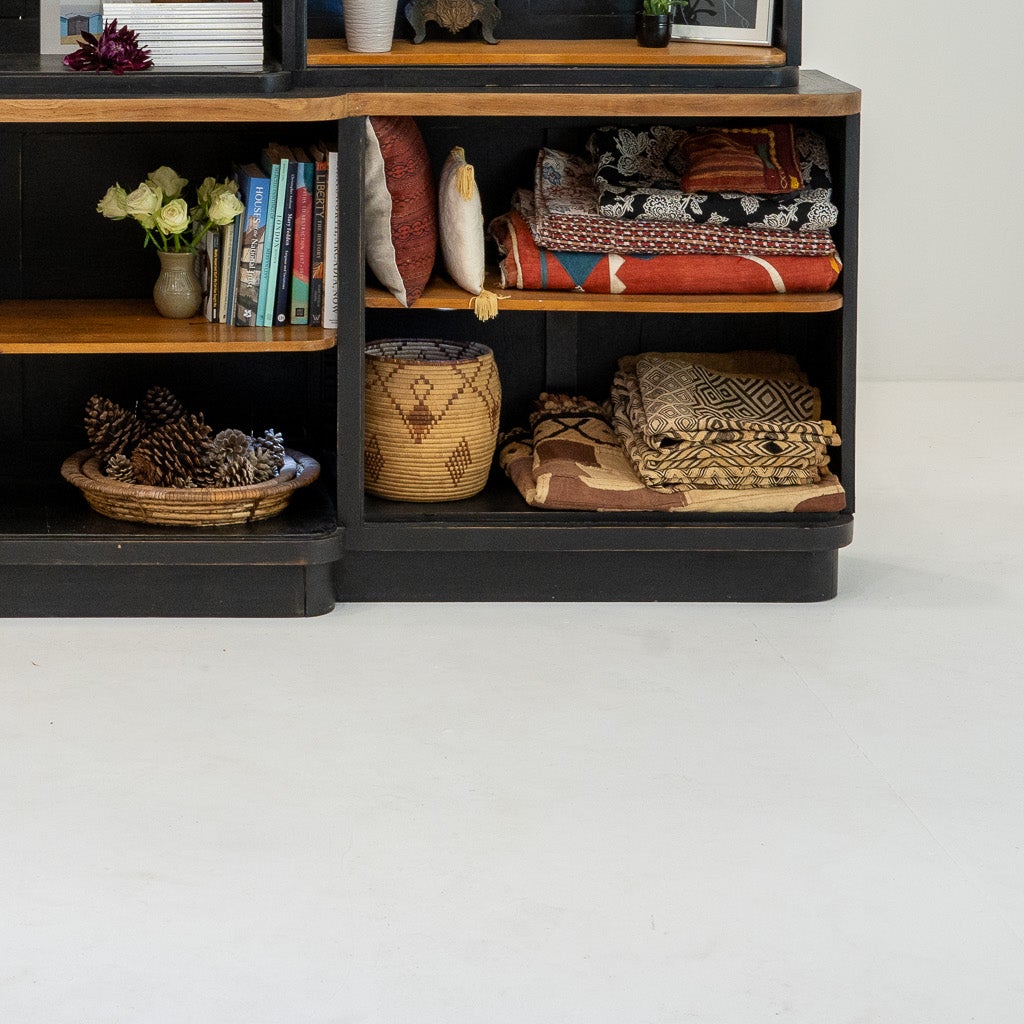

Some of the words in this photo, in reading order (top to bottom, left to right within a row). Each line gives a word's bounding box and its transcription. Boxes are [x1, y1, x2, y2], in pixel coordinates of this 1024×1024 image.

[252, 186, 264, 226] HOUSES
[315, 174, 326, 218] LIBERTY
[273, 215, 282, 248] LONDON
[248, 238, 258, 269] National
